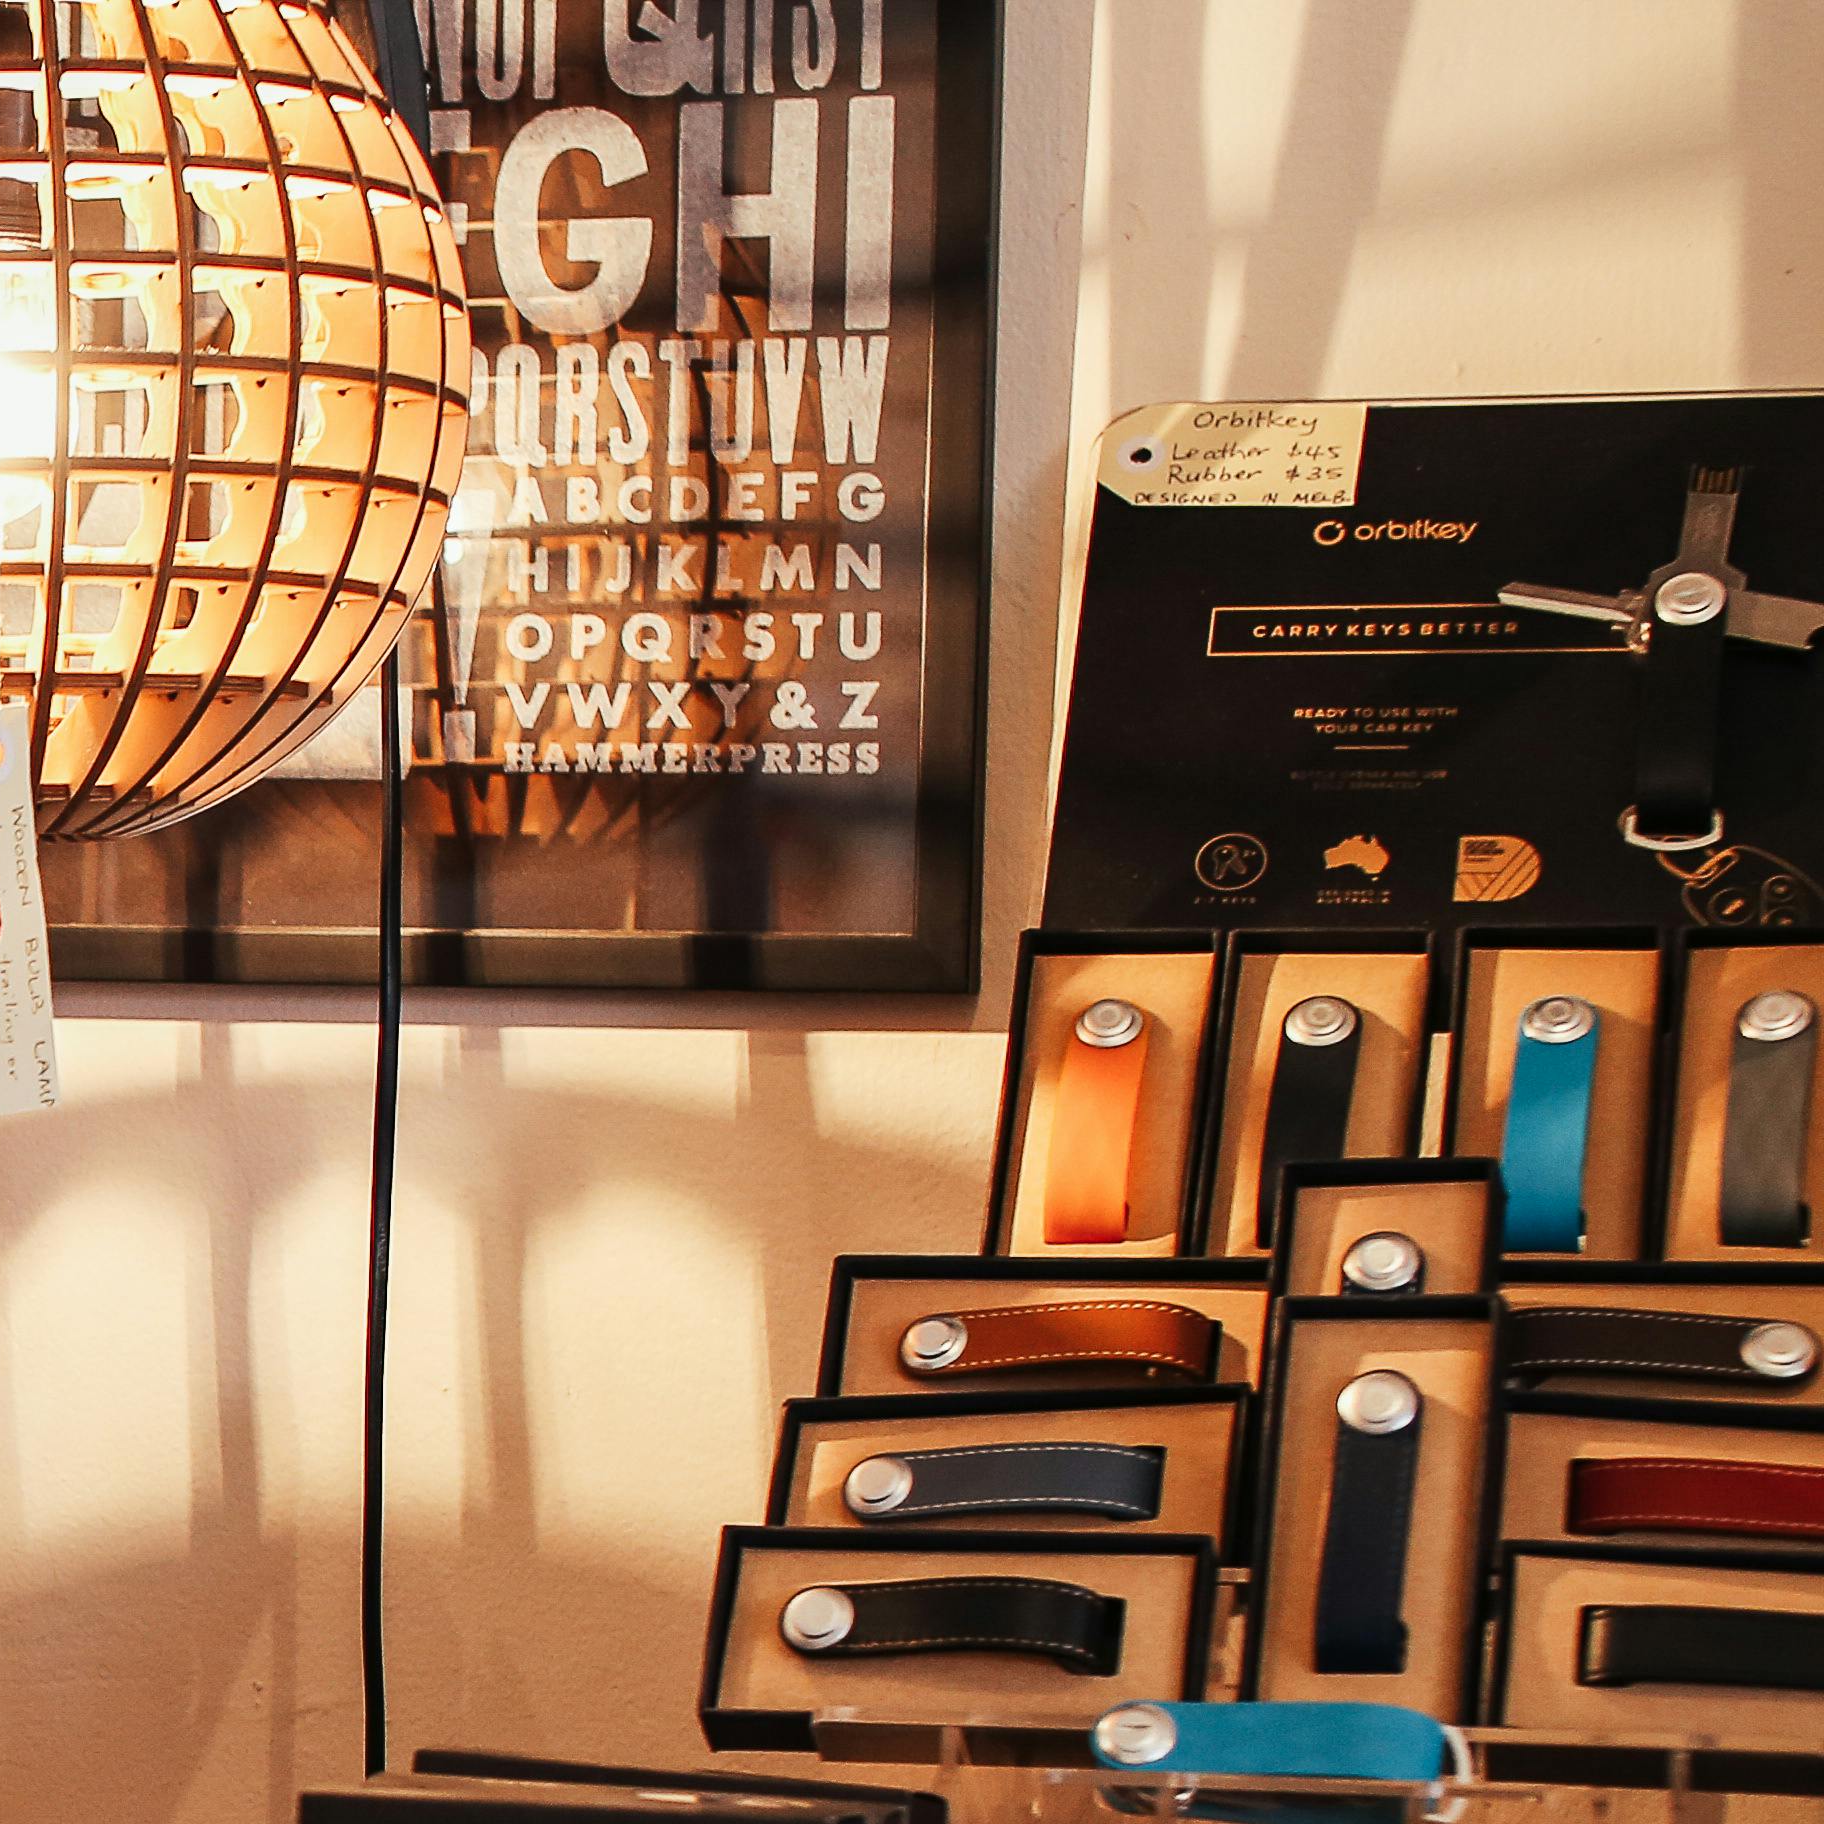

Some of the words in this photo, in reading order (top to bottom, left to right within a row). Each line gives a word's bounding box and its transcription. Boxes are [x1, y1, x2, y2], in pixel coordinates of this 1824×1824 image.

[1194, 411, 1318, 436] Orbitkey
[1172, 443, 1270, 461] Leather
[1168, 464, 1263, 484] Rubber
[1286, 465, 1343, 483] $35
[1134, 492, 1237, 504] DESIGNED
[1354, 520, 1478, 544] orbitkey
[1252, 624, 1338, 638] CARRY
[1346, 623, 1411, 636] KEYS
[1420, 622, 1519, 636] BETTER
[1293, 708, 1347, 718] READY
[1353, 708, 1373, 718] TO
[1379, 708, 1410, 718] USE
[1415, 707, 1458, 717] WITH
[1314, 724, 1358, 734] YOUR
[1364, 724, 1397, 733] CAR
[1402, 723, 1434, 733] KEY
[503, 742, 881, 774] HAMMERPRESS
[24, 938, 44, 1015] BULB
